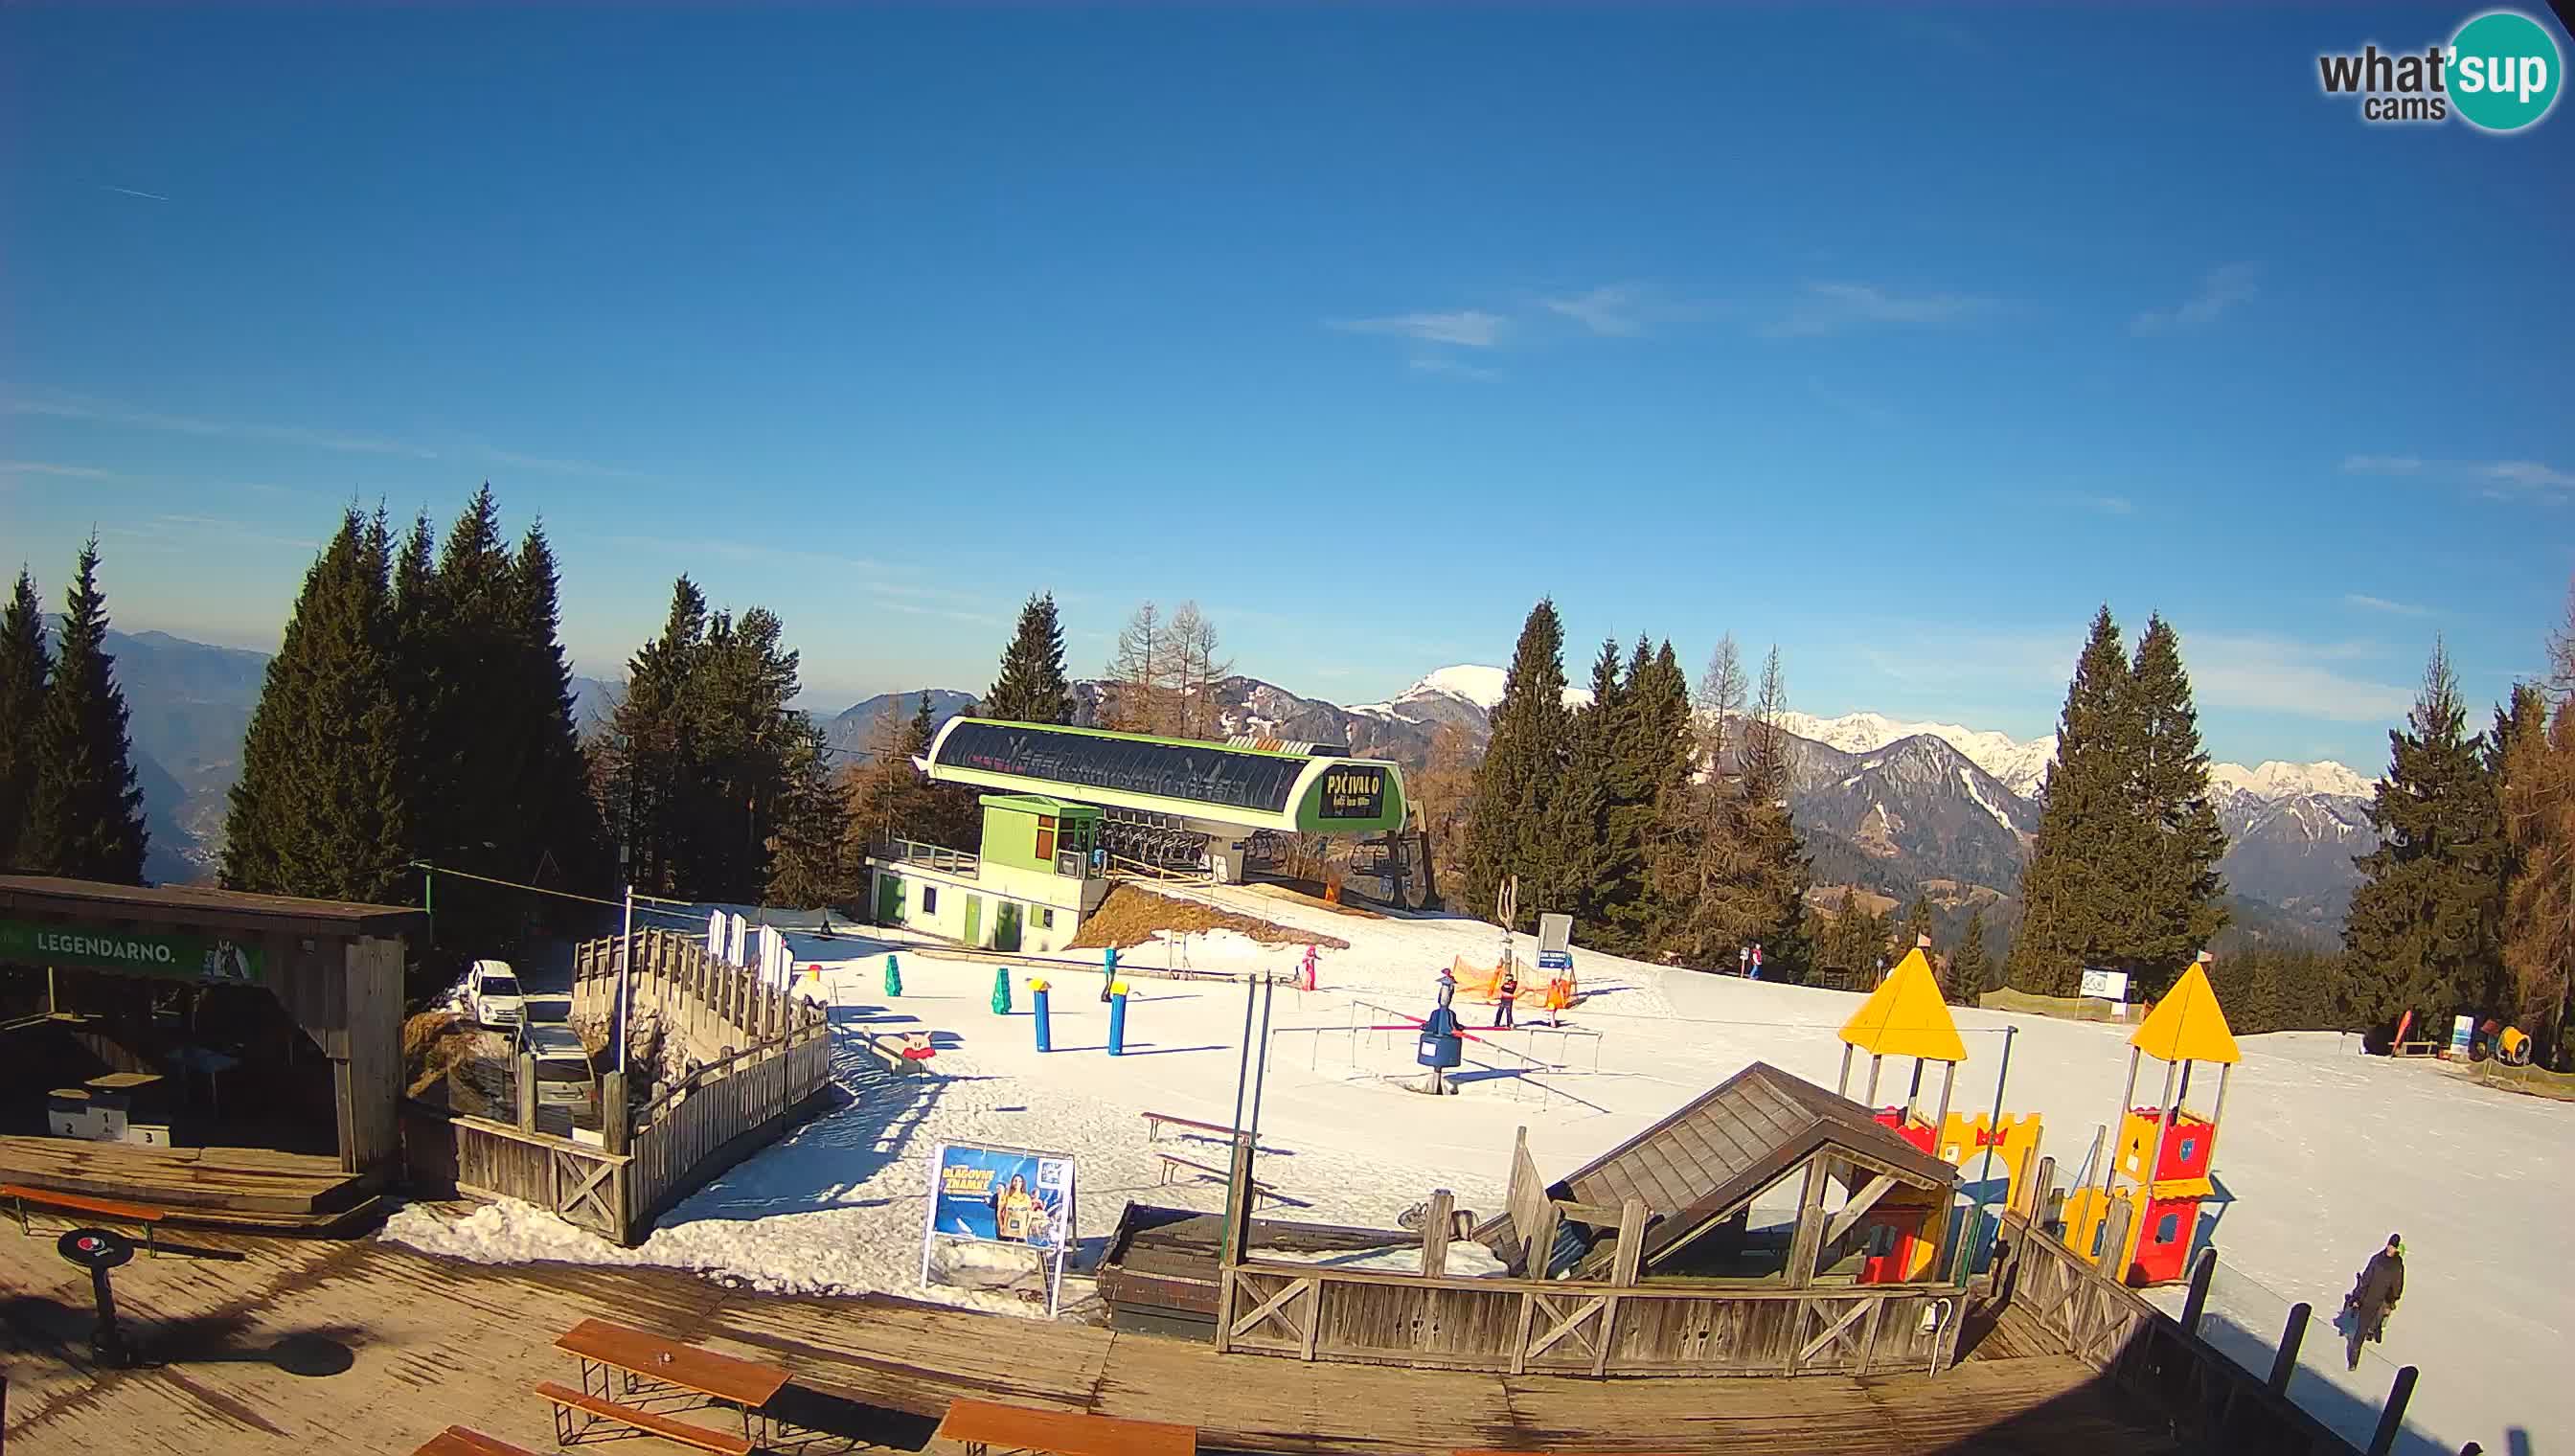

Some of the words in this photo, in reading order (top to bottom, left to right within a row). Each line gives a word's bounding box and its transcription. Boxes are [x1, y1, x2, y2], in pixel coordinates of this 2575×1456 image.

[37, 932, 176, 964] LEGENDARNO.
[65, 1122, 74, 1135] 2
[145, 1132, 153, 1144] 3
